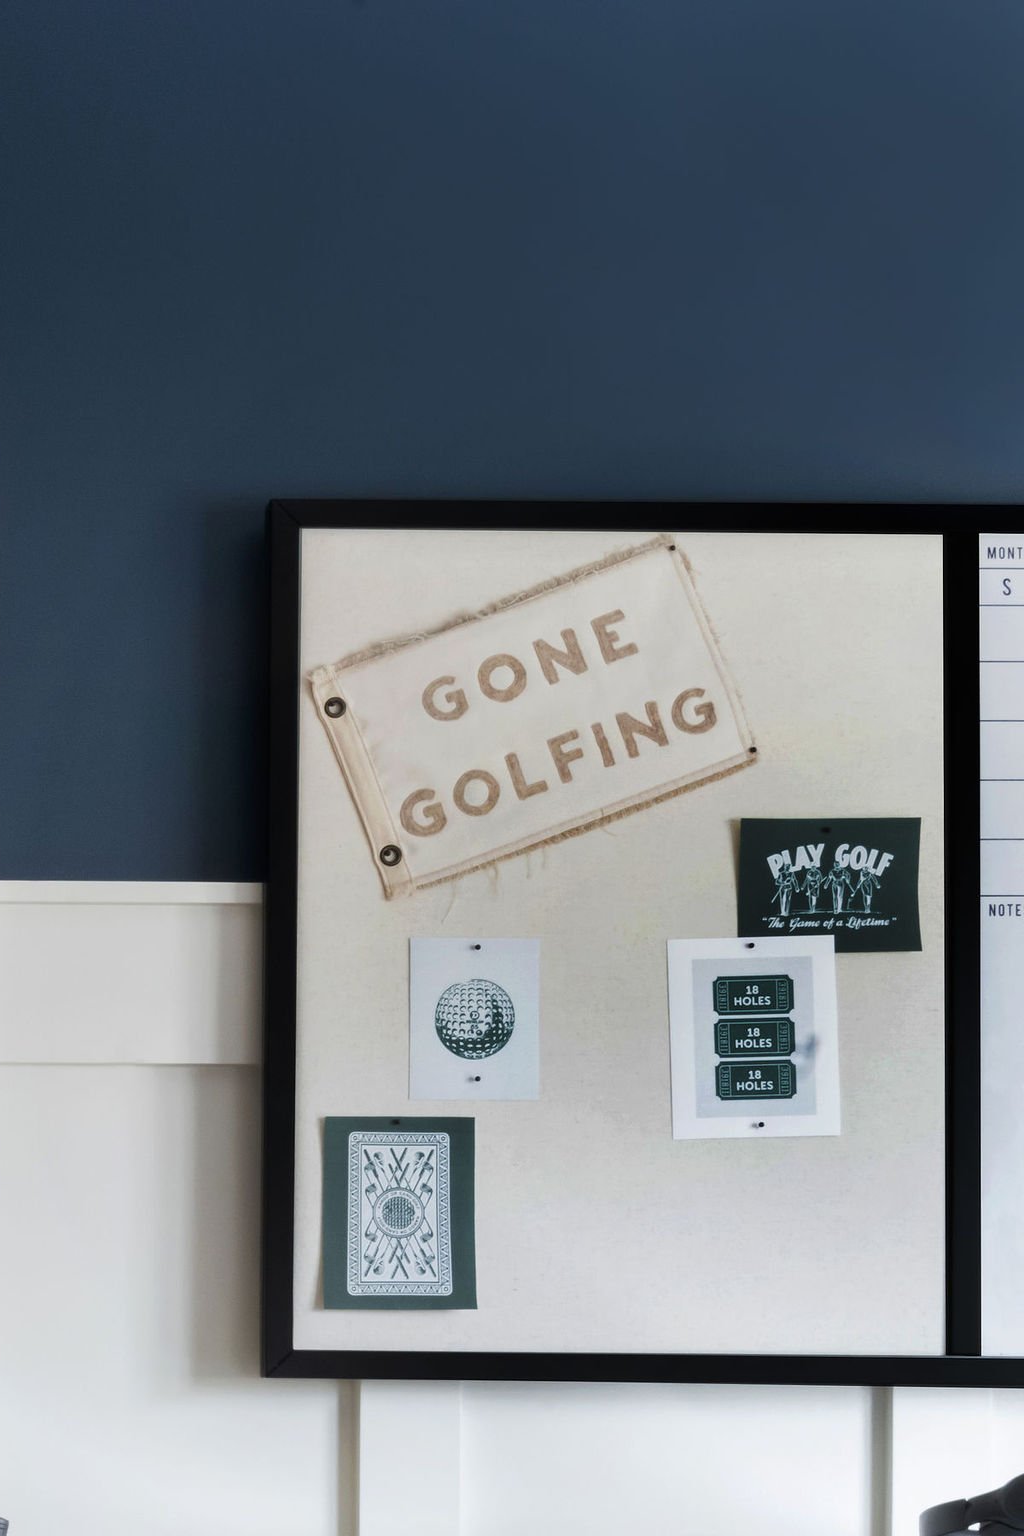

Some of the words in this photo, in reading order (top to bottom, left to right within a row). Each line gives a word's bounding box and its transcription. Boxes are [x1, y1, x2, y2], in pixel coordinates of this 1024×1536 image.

[1002, 578, 1012, 596] S
[421, 608, 639, 722] GONE
[399, 687, 718, 838] GOLFING
[766, 843, 825, 879] PLAY
[834, 843, 894, 877] GOLF
[988, 903, 1022, 917] NOTE
[789, 917, 820, 932] Game
[823, 917, 836, 930] of
[836, 919, 844, 927] a
[745, 985, 760, 995] 18
[734, 995, 772, 1006] HOLES
[747, 1027, 761, 1037] 18
[735, 1038, 773, 1048] HOLES
[748, 1070, 762, 1079] 18
[736, 1081, 774, 1091] HOLES
